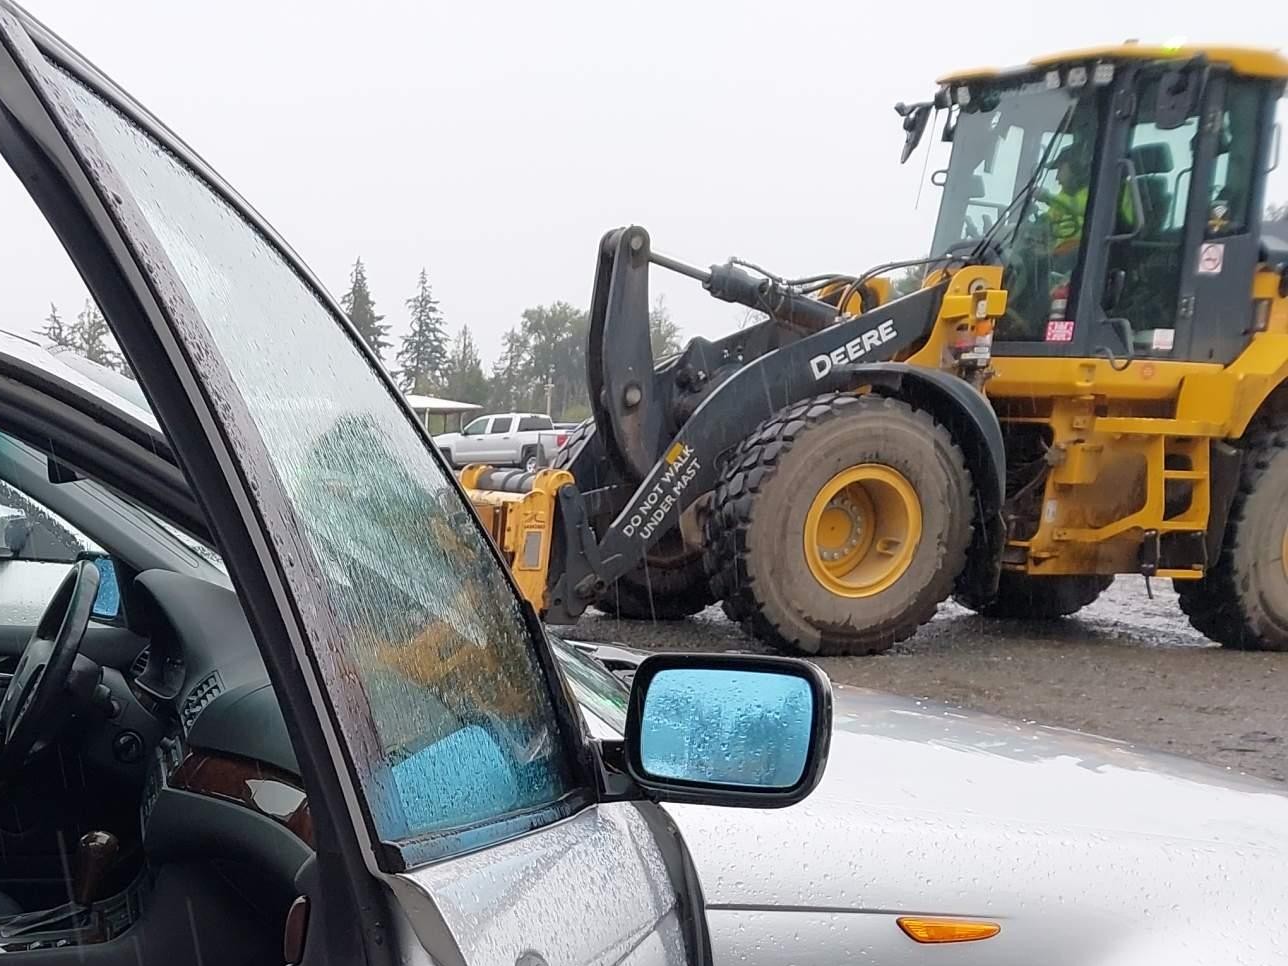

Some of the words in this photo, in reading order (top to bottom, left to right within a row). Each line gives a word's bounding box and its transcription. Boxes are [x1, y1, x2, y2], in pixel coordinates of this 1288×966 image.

[810, 319, 898, 380] DEERE
[623, 514, 642, 537] DO
[639, 483, 663, 515] NOT
[661, 445, 694, 483] WALK
[640, 495, 676, 539] UNDER
[672, 457, 701, 495] MAST
